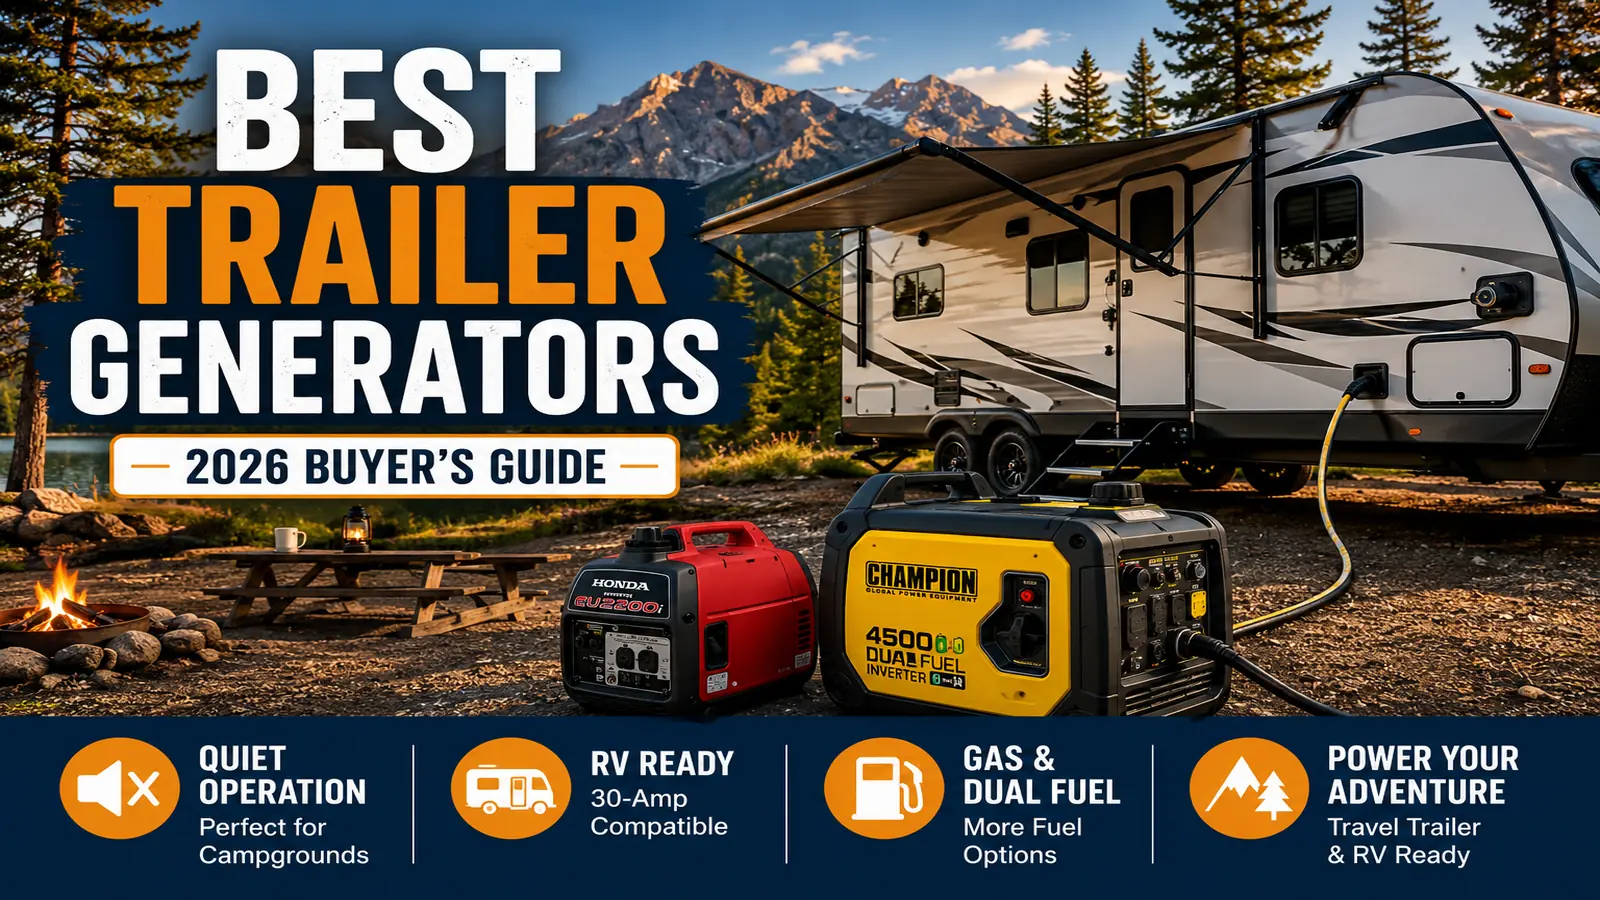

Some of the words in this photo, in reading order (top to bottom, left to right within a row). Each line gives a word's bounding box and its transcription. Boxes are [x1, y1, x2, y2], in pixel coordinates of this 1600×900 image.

[591, 578, 650, 591] HONDA
[867, 563, 976, 595] CHAMPION
[866, 626, 933, 651] 4500
[866, 663, 927, 684] INVERTER
[920, 653, 966, 674] FUEL
